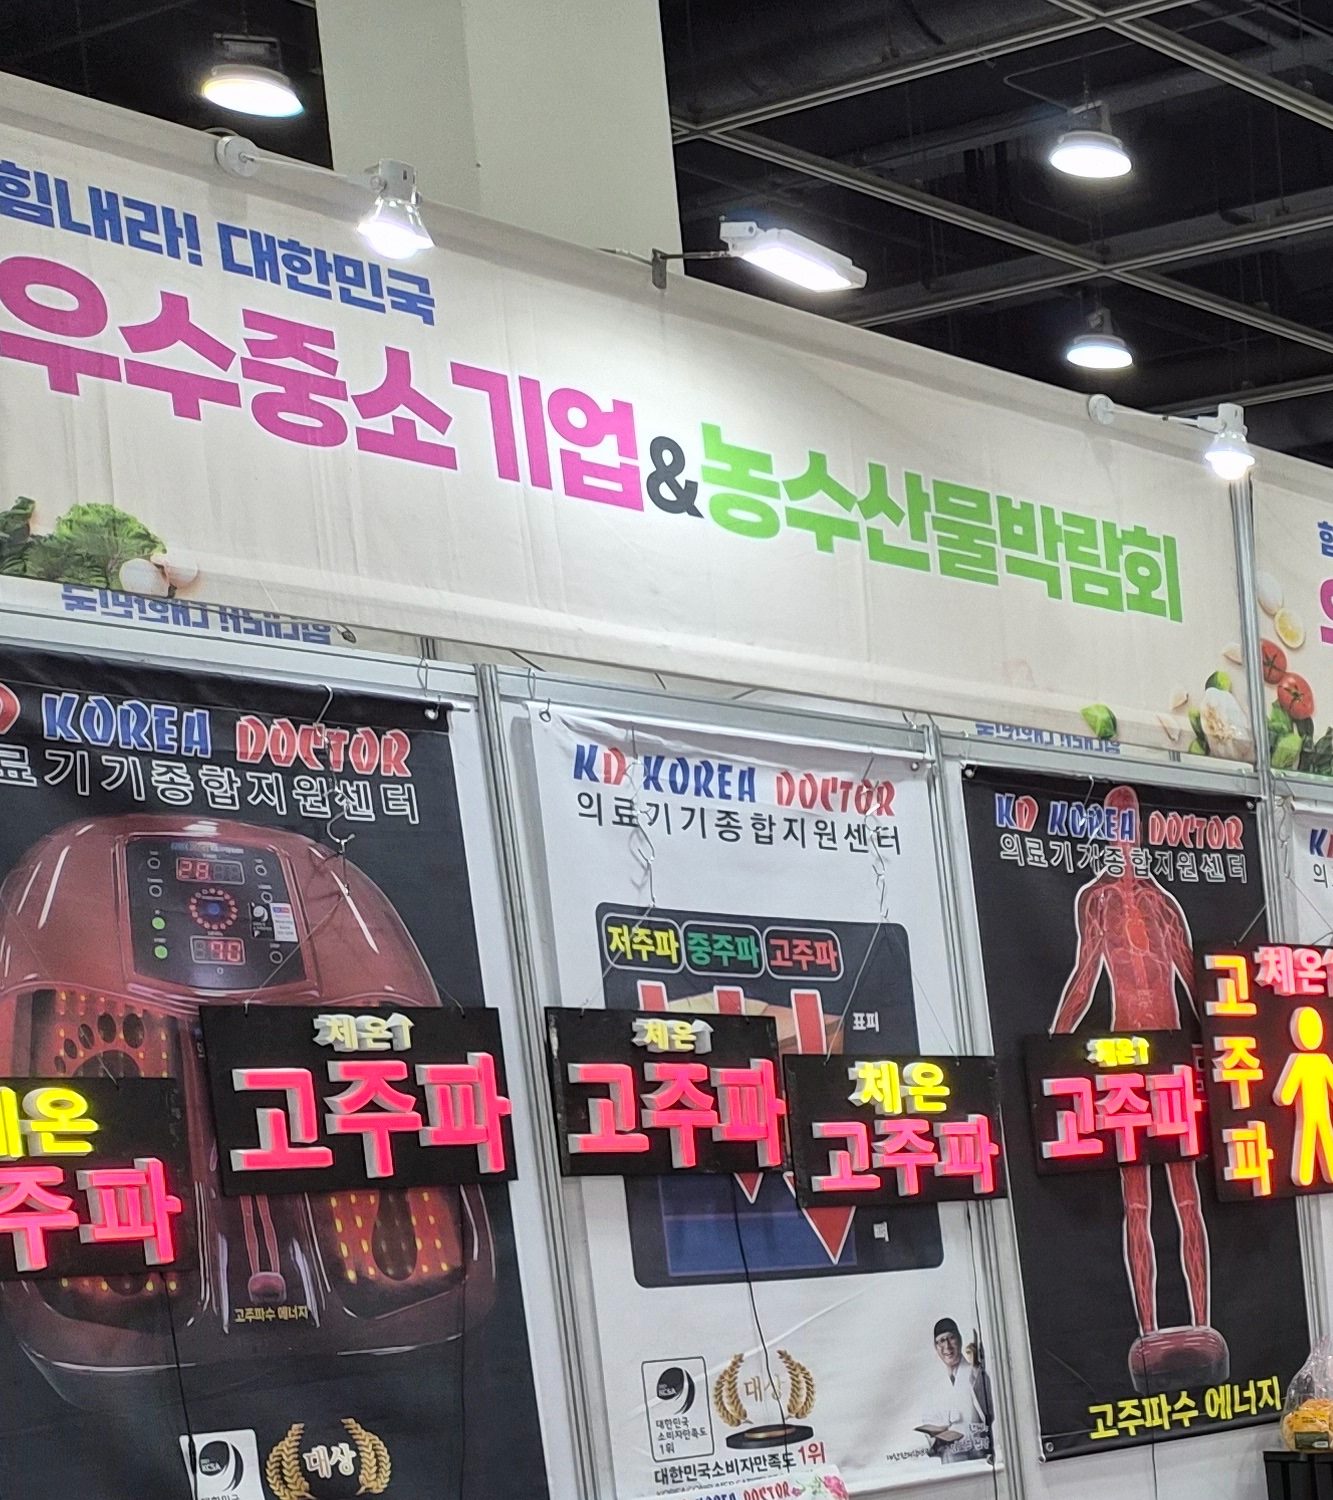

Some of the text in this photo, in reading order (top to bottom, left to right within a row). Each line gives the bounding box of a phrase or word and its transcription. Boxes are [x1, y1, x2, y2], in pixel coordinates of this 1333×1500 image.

[0, 159, 436, 326] 힘내라! 대한민국
[41, 691, 414, 784] KOREA DOCTOR
[573, 744, 896, 817] KD KOREA DOCTOR
[577, 791, 901, 855] 의료기기종합지원센터
[995, 793, 1244, 850] KD KOREA DOCTOR
[999, 833, 1247, 883] 의료기기종합지원센터
[608, 924, 839, 972] 저주파 중주파 고주파
[1254, 945, 1327, 998] 체온
[313, 1013, 397, 1052] 체온
[230, 1052, 513, 1179] 고주파
[567, 1058, 787, 1169] 고주파
[848, 1060, 952, 1116] 체온
[1042, 1063, 1207, 1164] 고주파
[813, 1112, 1000, 1196] 고주파
[1088, 1376, 1282, 1440] 고주파수 에너지
[302, 1442, 357, 1479] 대상
[654, 1442, 826, 1486] 대한민국소비자만족도 1위
